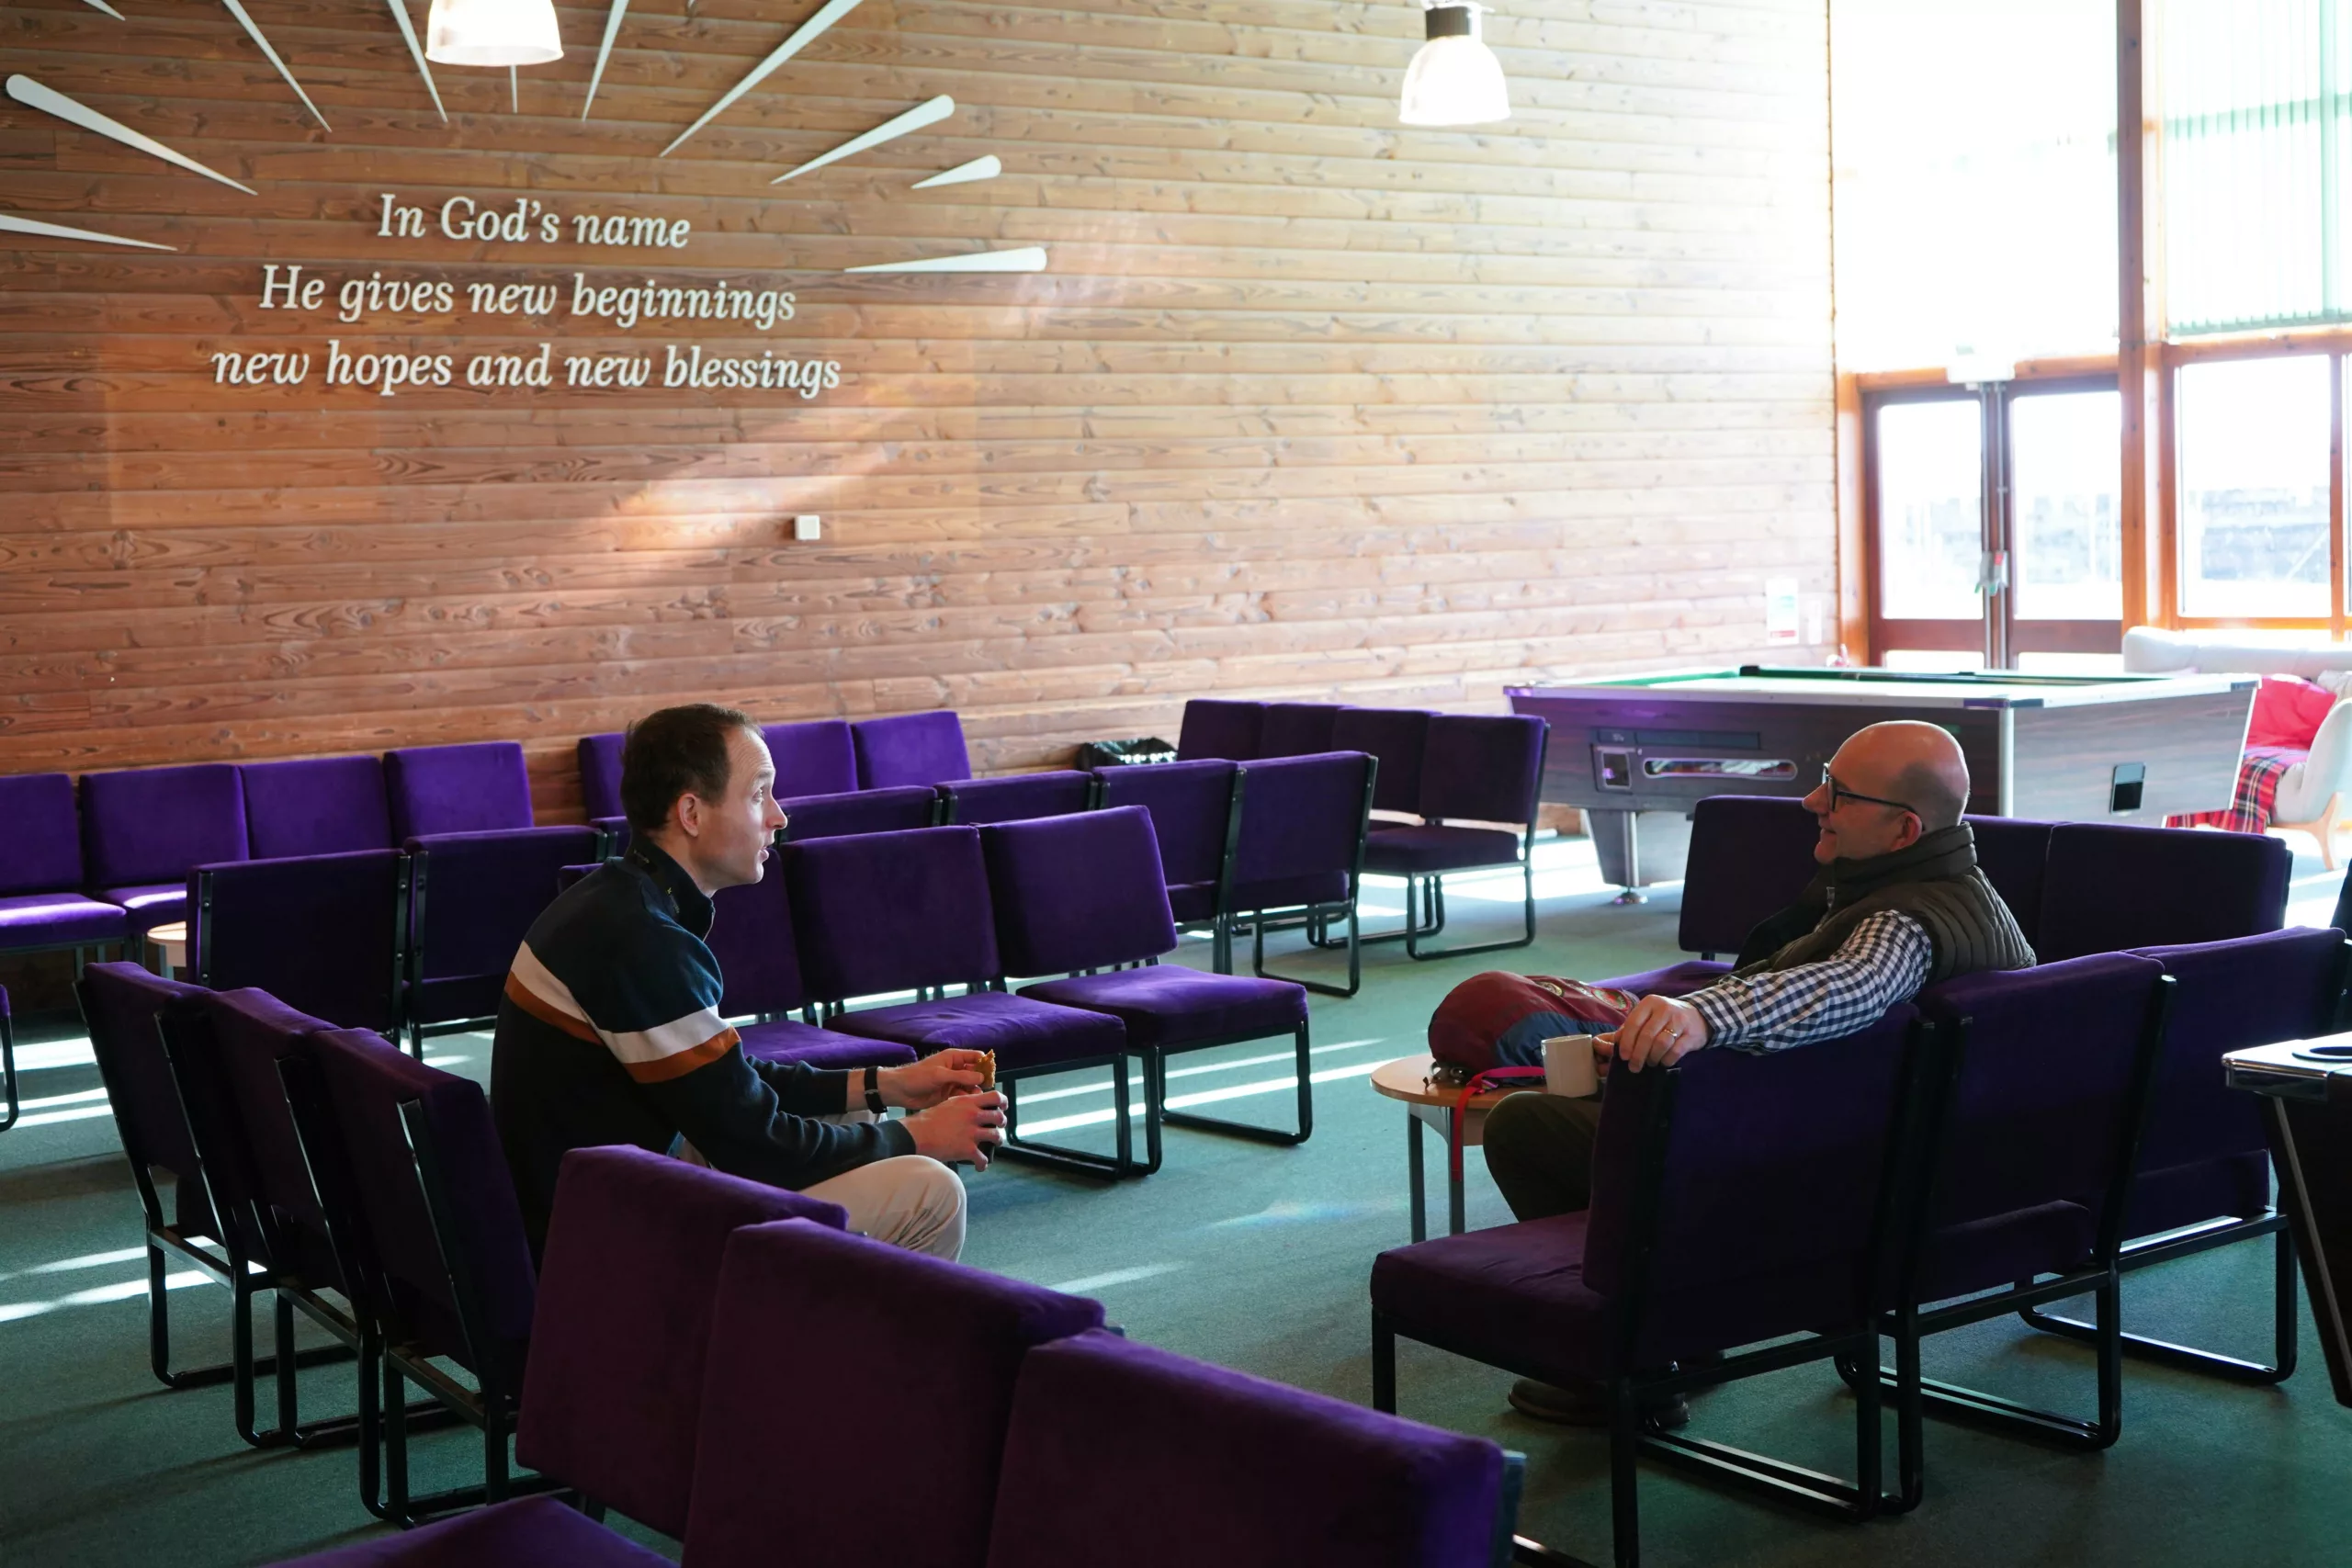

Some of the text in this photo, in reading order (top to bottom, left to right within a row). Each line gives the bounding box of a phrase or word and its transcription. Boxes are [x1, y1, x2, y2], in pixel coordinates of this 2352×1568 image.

[378, 194, 691, 248] In God’s name
[259, 264, 797, 331] He gives new beginnings
[211, 339, 842, 400] new hopes and new blessings
